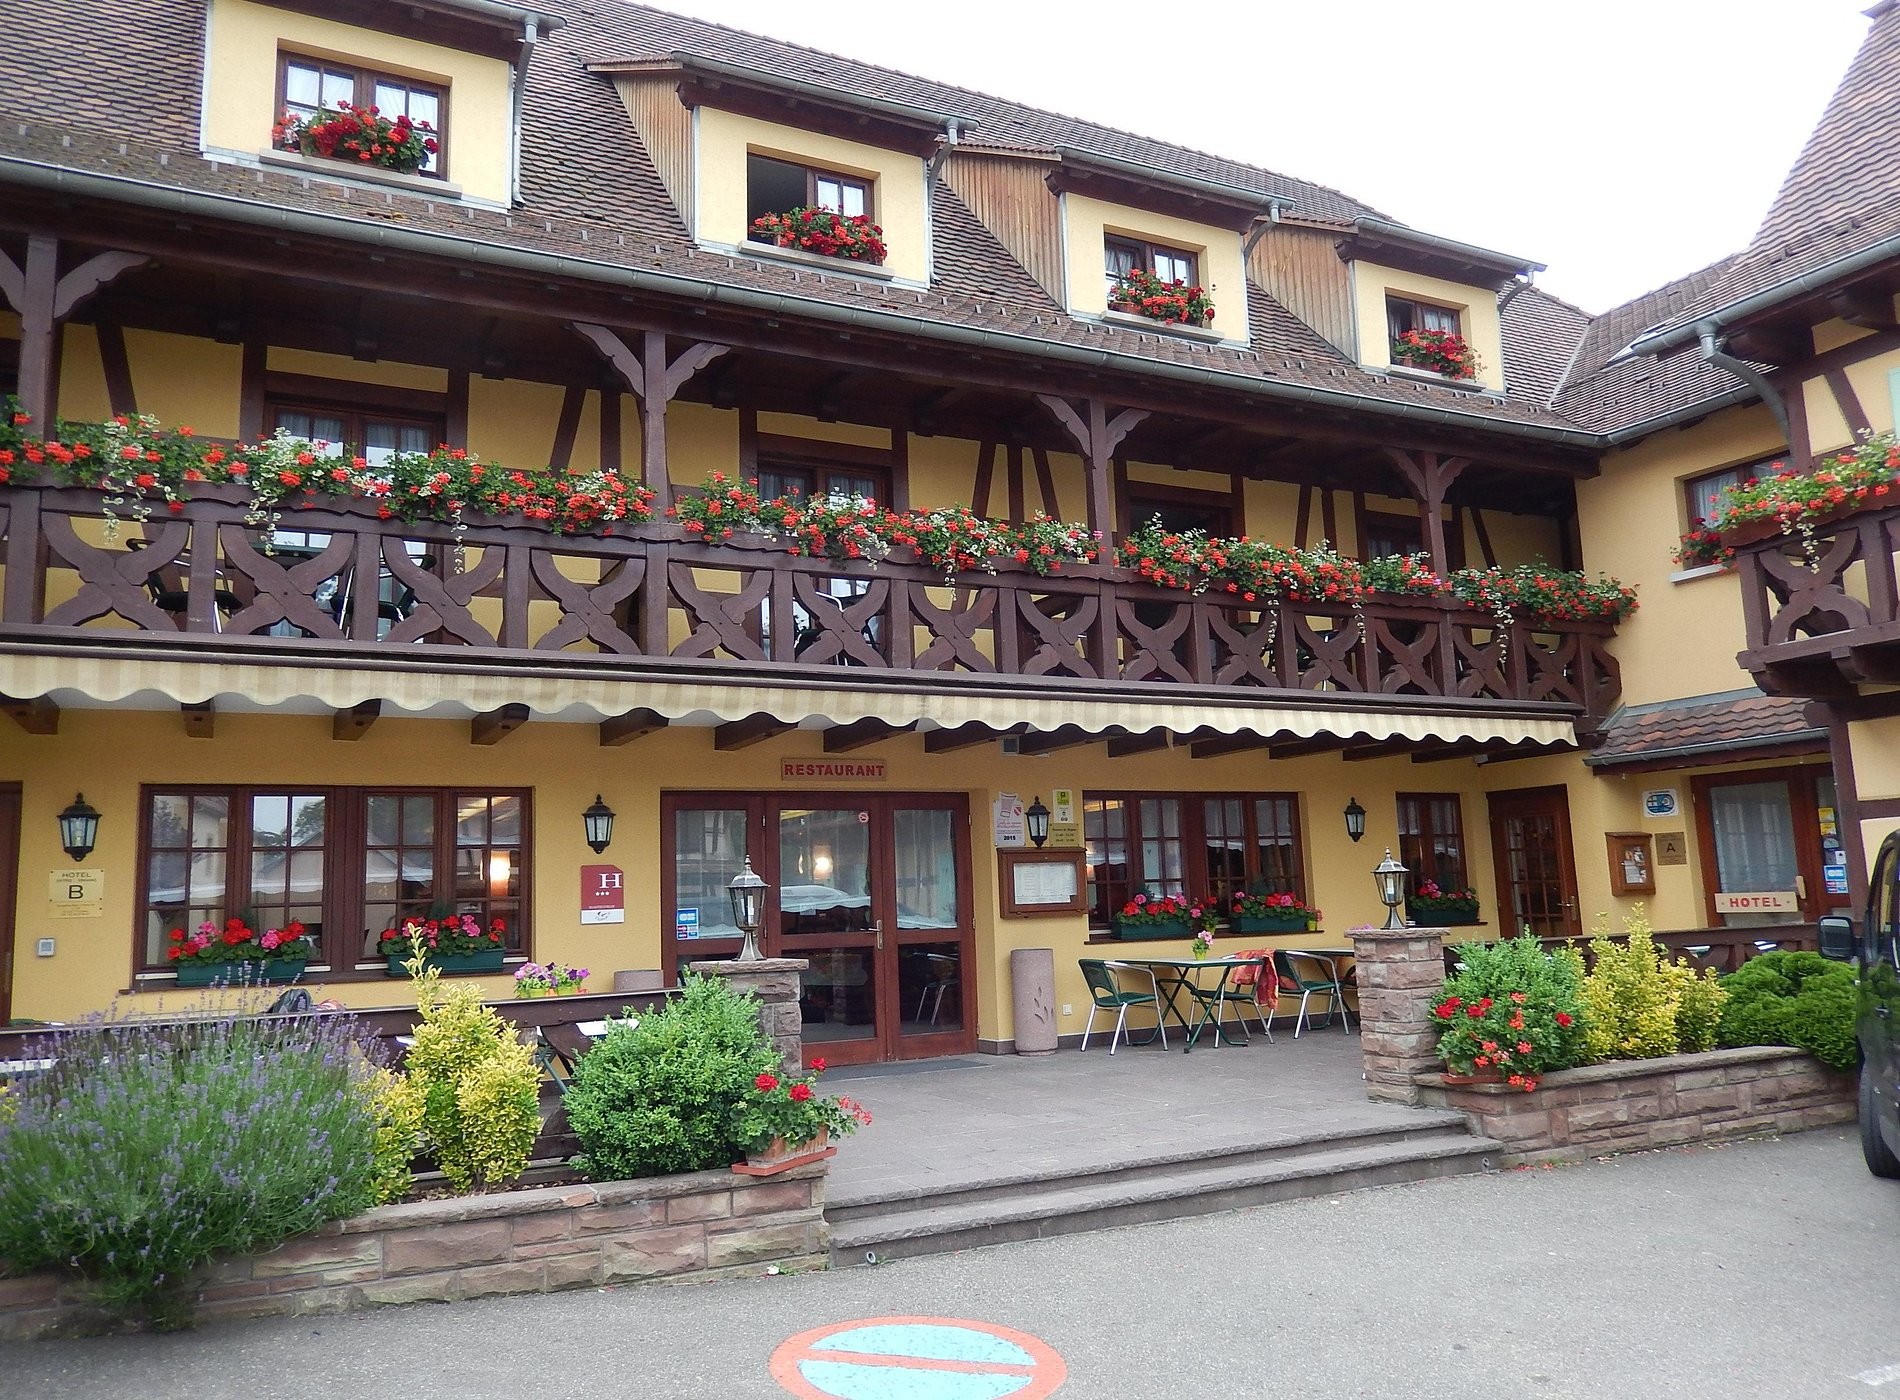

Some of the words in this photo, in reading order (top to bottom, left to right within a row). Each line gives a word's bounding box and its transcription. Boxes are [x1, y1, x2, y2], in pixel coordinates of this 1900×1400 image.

[784, 764, 885, 776] RESTAURANT
[1667, 842, 1676, 852] A
[598, 873, 623, 889] H
[69, 885, 84, 899] B
[1729, 897, 1782, 908] HOTEL
